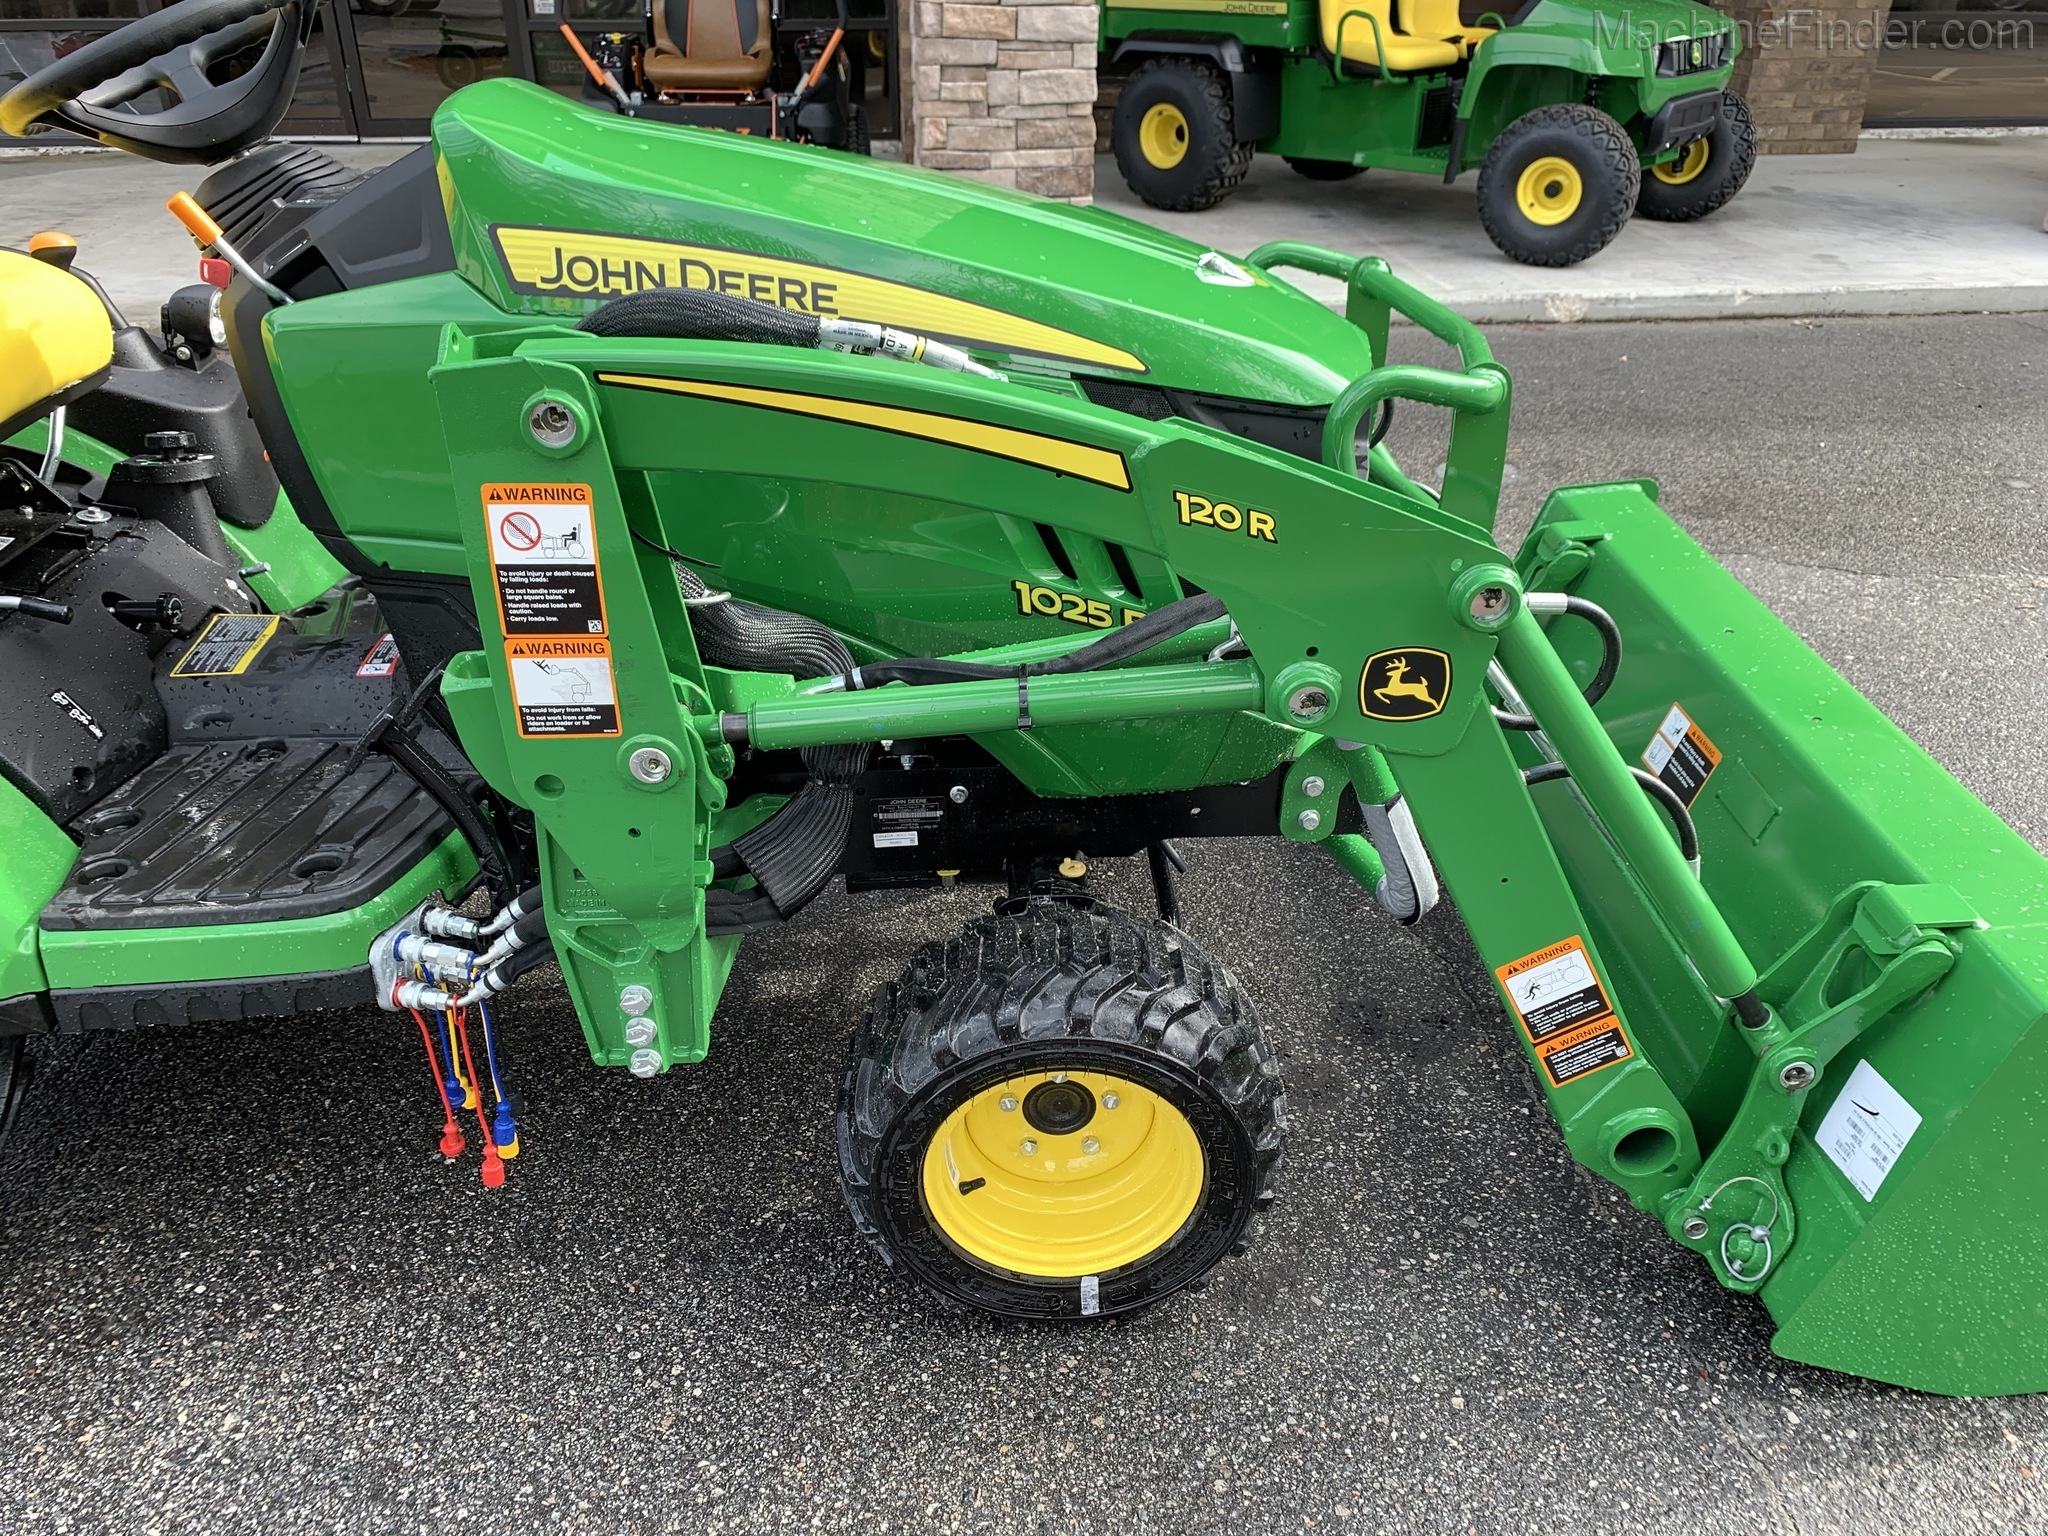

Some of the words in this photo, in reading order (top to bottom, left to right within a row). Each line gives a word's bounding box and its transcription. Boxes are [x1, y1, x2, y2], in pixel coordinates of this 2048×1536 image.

[1223, 3, 1247, 12] JOHN
[1248, 2, 1277, 13] DEERE
[540, 247, 666, 290] JOHN
[680, 257, 839, 315] DEERE
[503, 488, 586, 501] WARNING
[1174, 490, 1243, 532] 120
[1248, 509, 1278, 543] R
[1012, 580, 1113, 628] 1025
[526, 642, 605, 654] WARNING
[1695, 734, 1716, 758] WARNING
[1520, 943, 1572, 969] WARNING
[1559, 1022, 1610, 1047] WARNING
